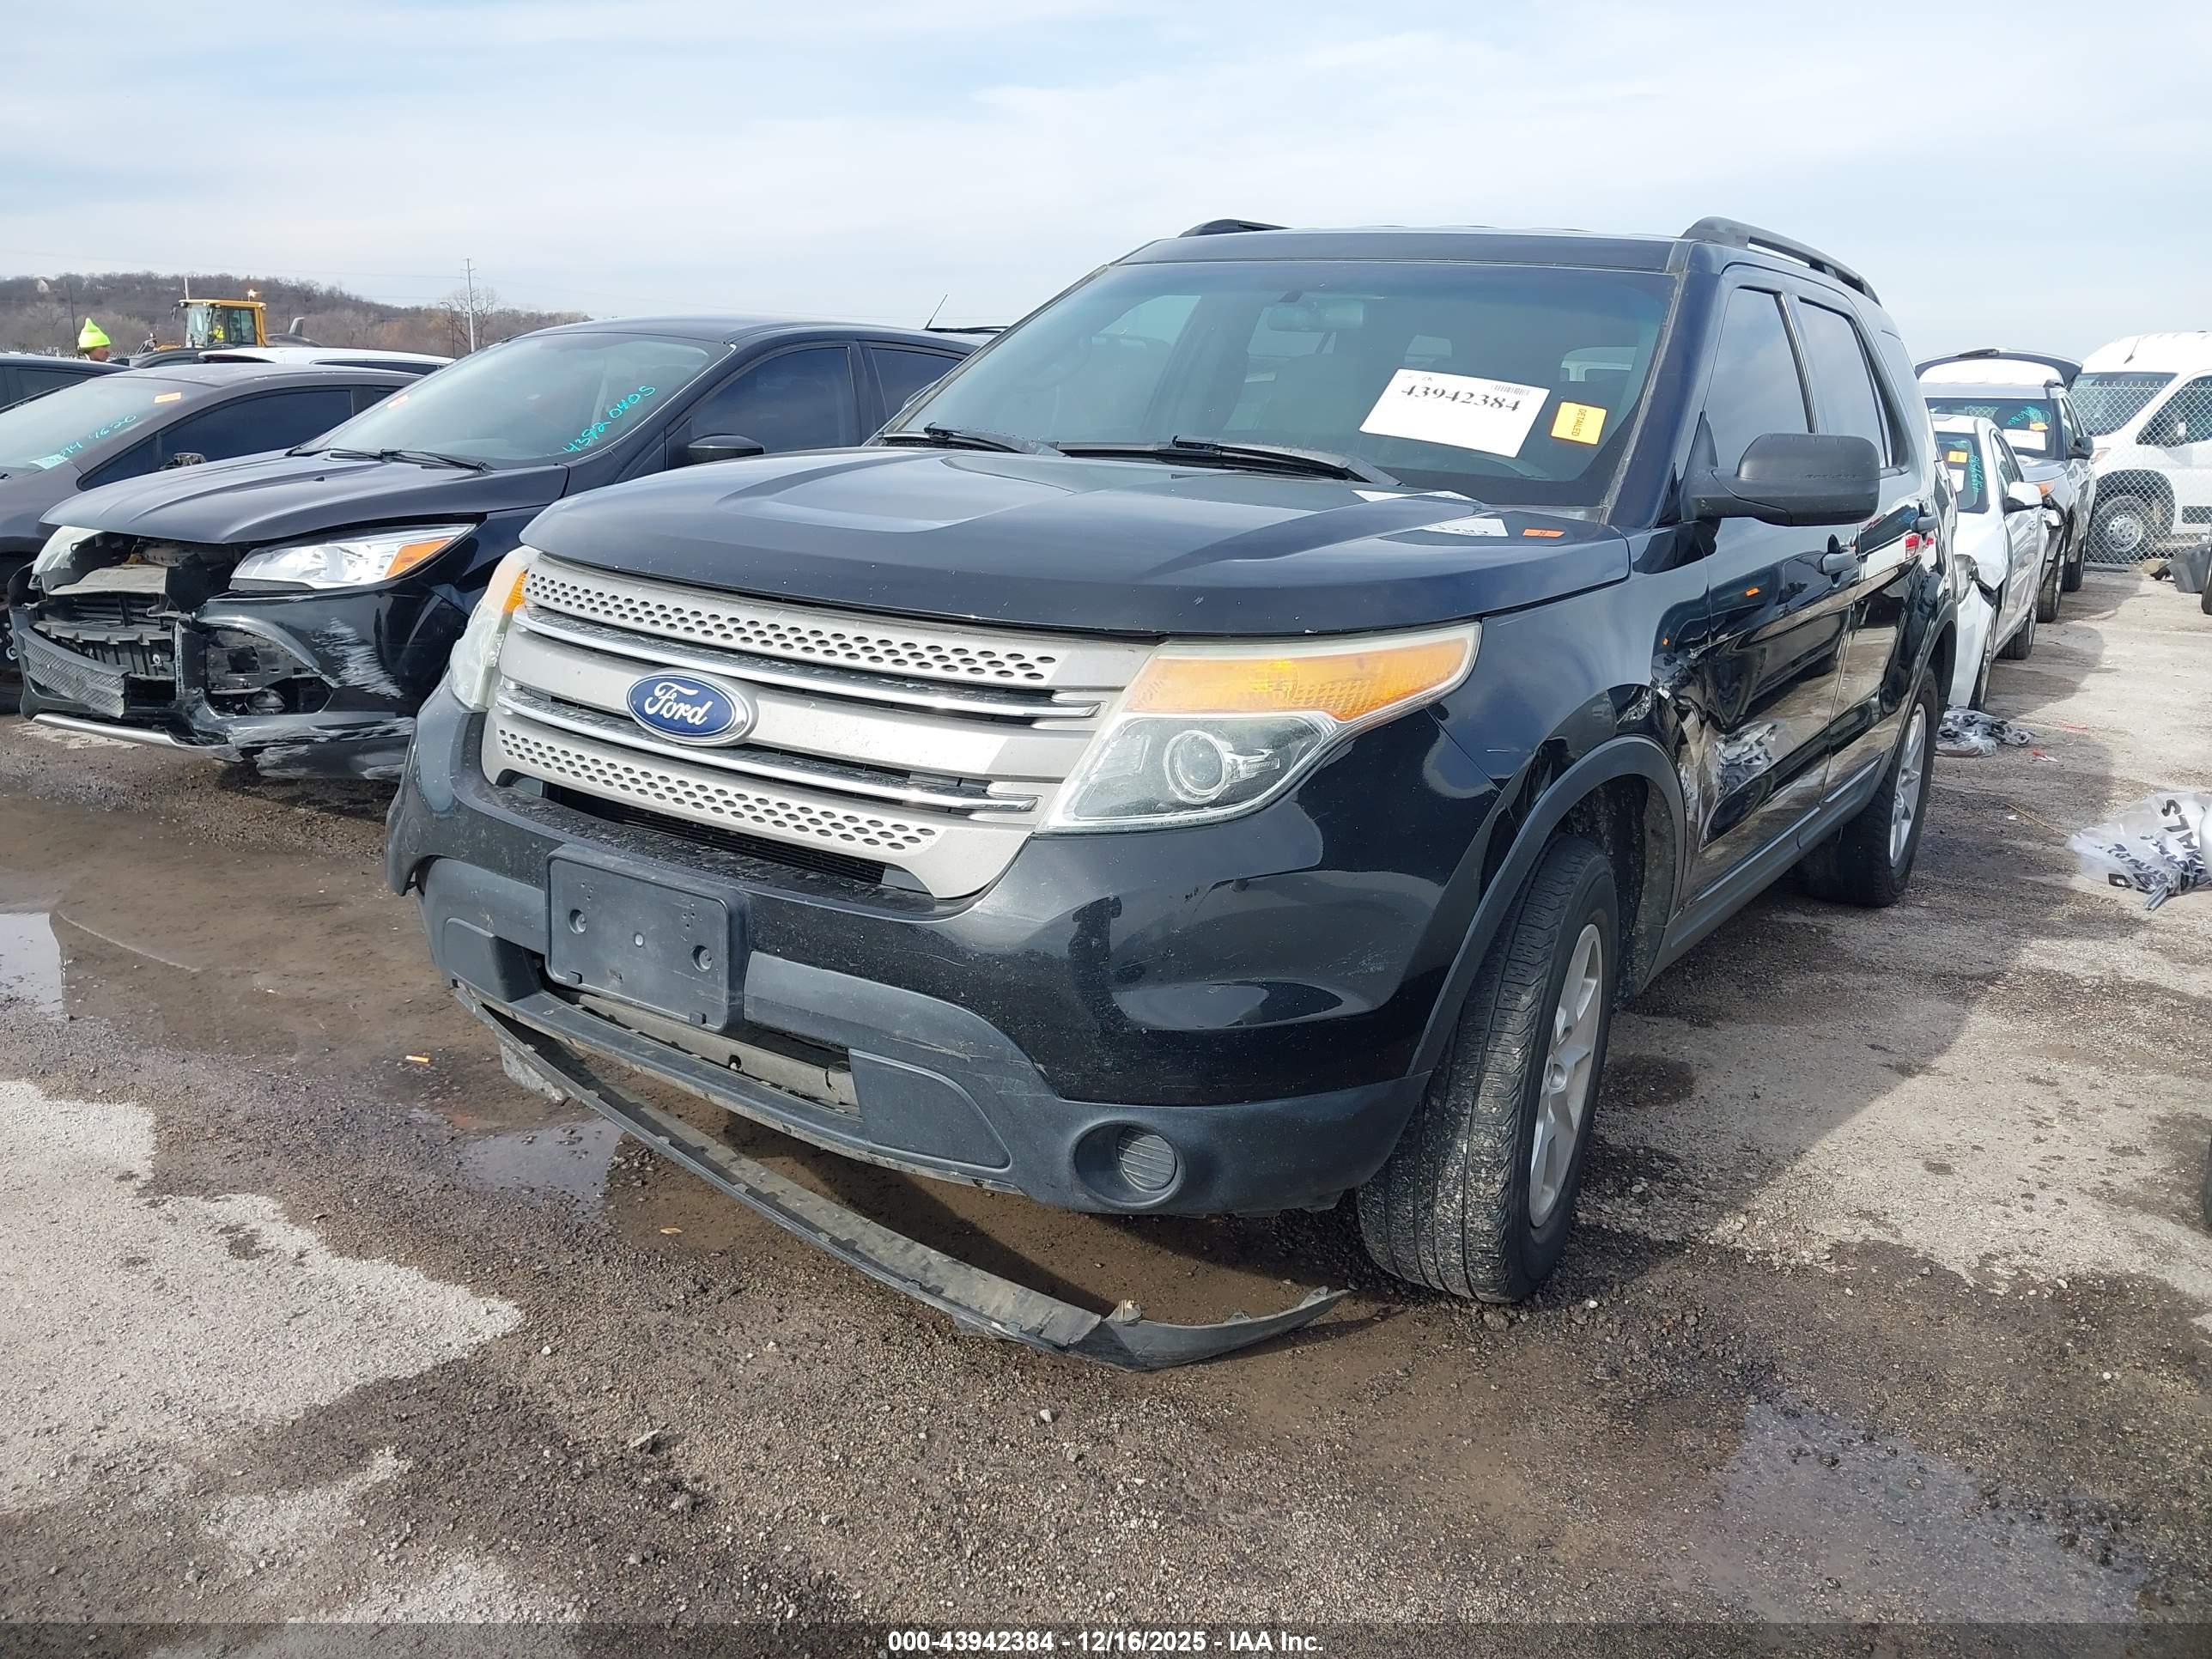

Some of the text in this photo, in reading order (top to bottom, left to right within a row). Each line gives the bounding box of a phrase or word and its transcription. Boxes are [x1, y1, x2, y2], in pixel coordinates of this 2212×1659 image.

[1401, 384, 1521, 412] 43942384
[1571, 408, 1588, 437] DETAILED
[644, 681, 714, 726] Ford
